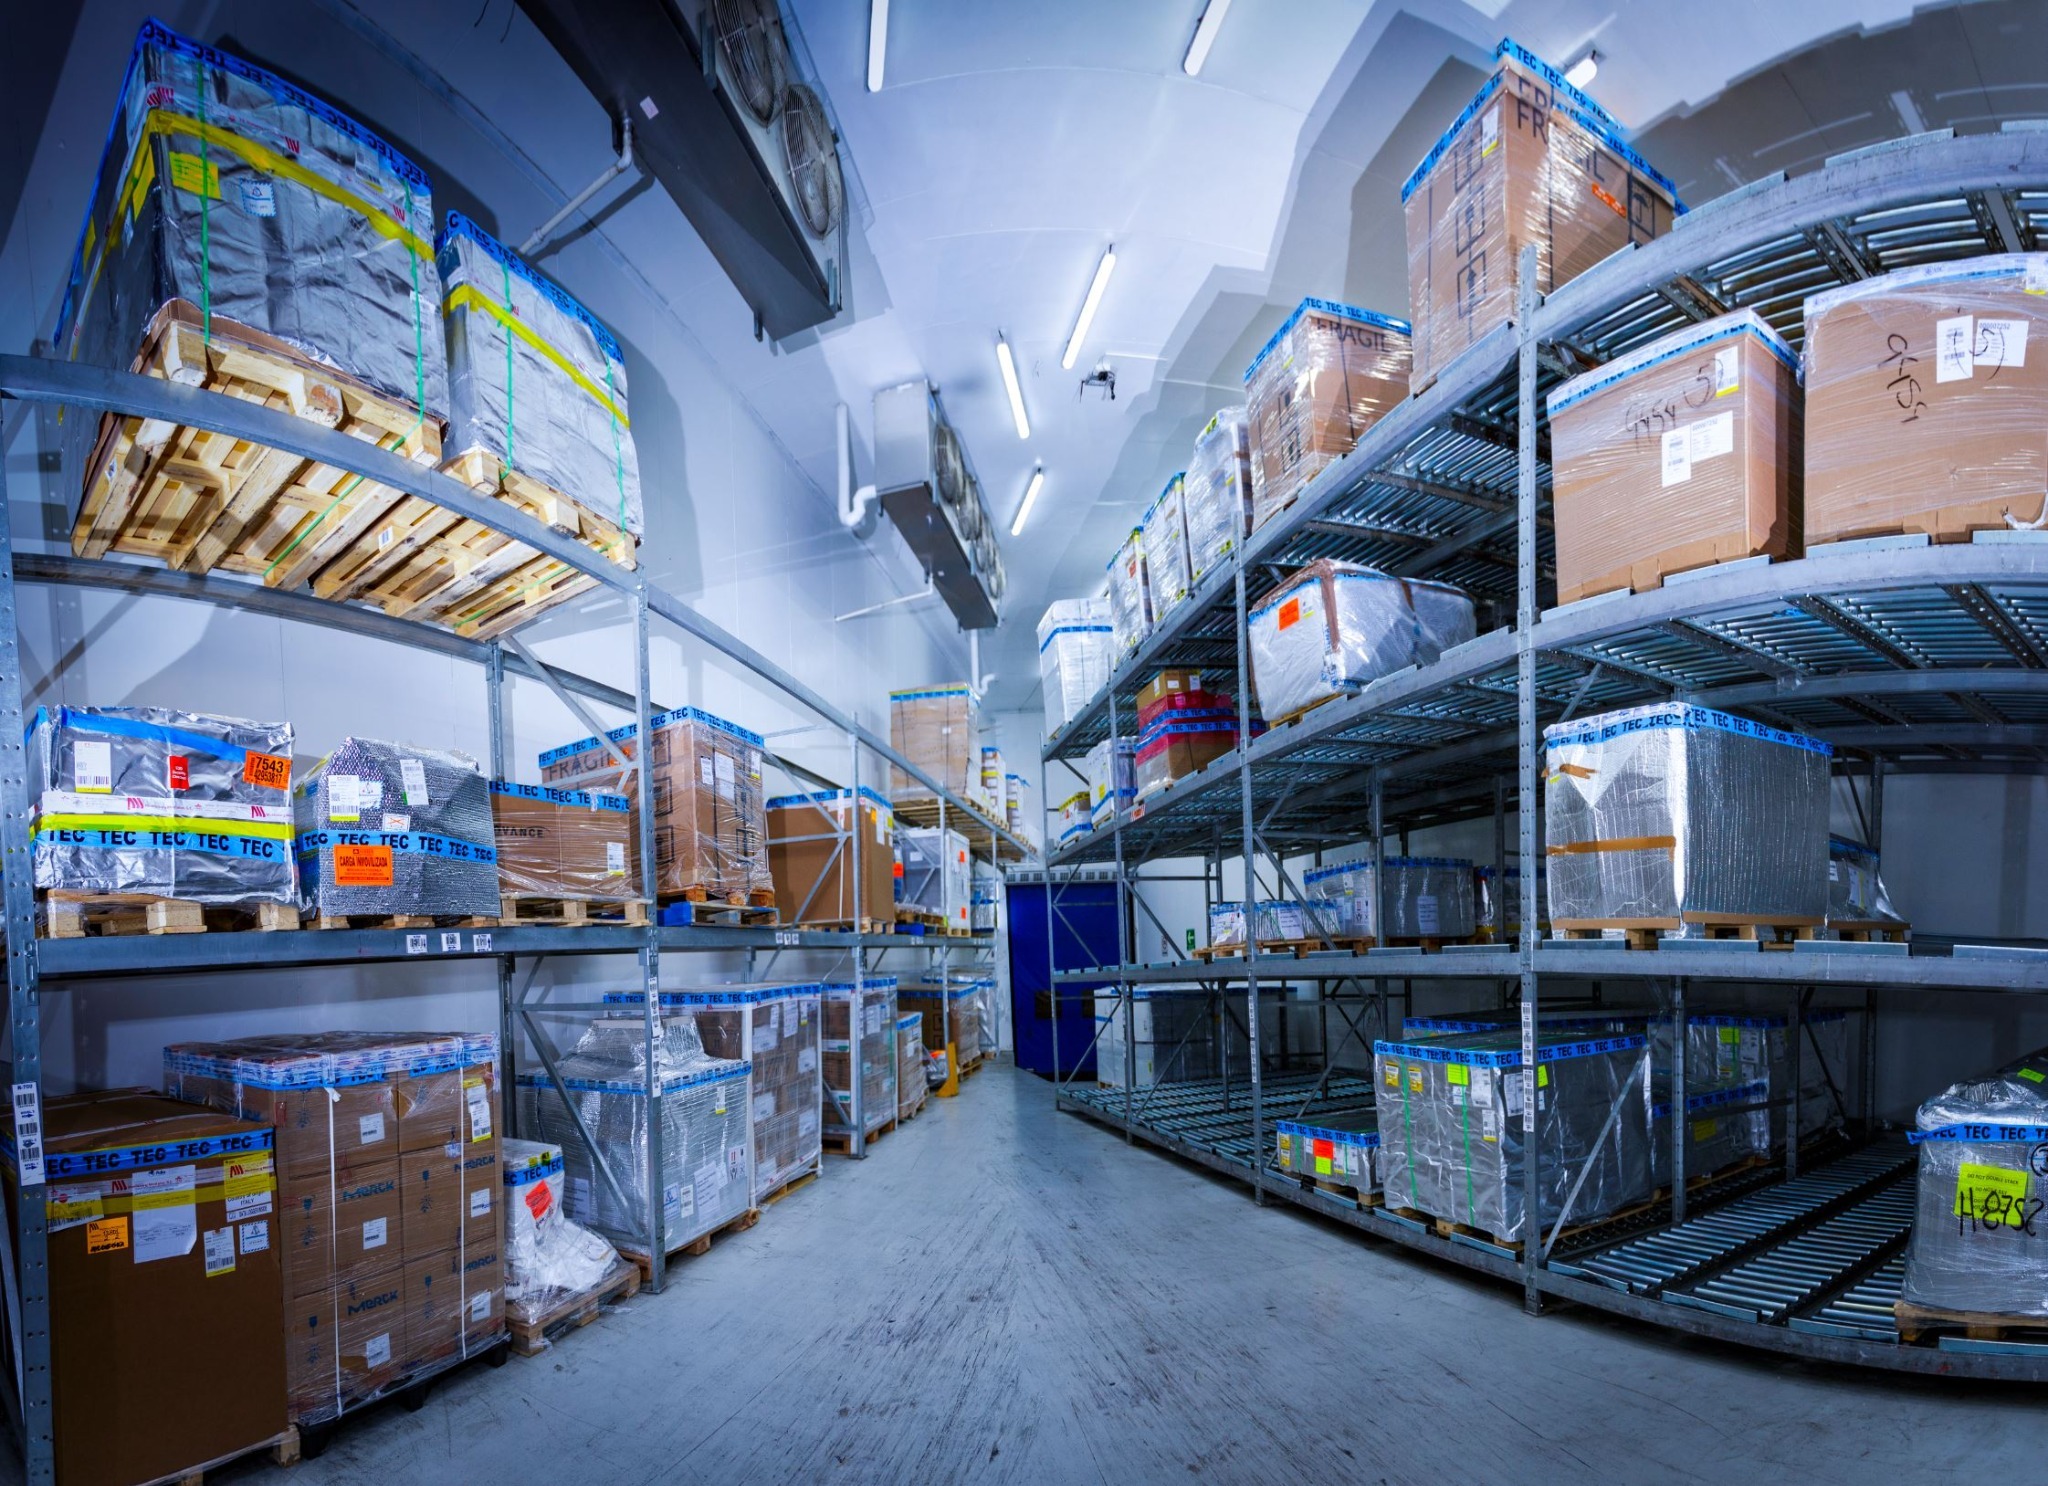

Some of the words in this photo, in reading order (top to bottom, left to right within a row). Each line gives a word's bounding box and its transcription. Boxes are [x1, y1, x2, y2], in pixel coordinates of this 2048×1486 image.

[1516, 44, 1537, 70] TEC
[1542, 64, 1562, 88] TEC
[1306, 298, 1322, 309] TEC
[1326, 302, 1342, 313] TEC
[1345, 307, 1361, 318] TEC
[1365, 312, 1381, 323] TEC
[555, 747, 568, 757] TEC
[572, 741, 586, 751] TEC
[591, 736, 600, 746] TE
[628, 722, 637, 734] TE
[671, 707, 688, 720] TEC
[693, 708, 706, 720] TEC
[751, 733, 760, 744] TEC
[1622, 718, 1642, 731] TEC
[1711, 713, 1729, 727] TEC
[1732, 718, 1749, 733] TEC
[1753, 723, 1770, 737] TEC
[255, 757, 284, 773] 7543
[489, 781, 510, 792] TEC
[517, 784, 538, 797] TEC
[577, 793, 591, 803] TE
[602, 796, 620, 809] TEC
[814, 793, 826, 801] TEC
[100, 829, 136, 846] TEC
[150, 830, 186, 846] TEC
[196, 832, 230, 851] TEC
[240, 836, 273, 858] TEC
[304, 833, 328, 847] TEC
[338, 834, 371, 846] TEC
[380, 834, 409, 849] TEC
[418, 836, 443, 853] TEC
[449, 842, 469, 857] TEC
[474, 848, 492, 861] TEC
[689, 995, 704, 1003] TEC
[708, 995, 723, 1003] TEC
[728, 994, 741, 1002] TEC
[1432, 1022, 1444, 1030] TEC
[1447, 1022, 1459, 1030] TEC
[1376, 1044, 1388, 1052] TEC
[1392, 1045, 1405, 1055] TEC
[1408, 1048, 1422, 1058] TEC
[1455, 1052, 1470, 1063] TEC
[1474, 1054, 1490, 1065] TEC
[1495, 1054, 1512, 1066] TEC
[1538, 1049, 1553, 1060] TEC
[1557, 1046, 1572, 1057] TEC
[1576, 1043, 1591, 1054] TEC
[1594, 1040, 1608, 1051] TEC
[1612, 1038, 1626, 1049] TEC
[1629, 1036, 1642, 1046] TEC
[1285, 1124, 1295, 1132] TEC
[1297, 1126, 1307, 1134] TEC
[1335, 1132, 1348, 1141] TEC
[1351, 1134, 1361, 1144] TEC
[1964, 1125, 1991, 1139] TEC
[2000, 1127, 2026, 1139] TEC
[44, 1157, 72, 1175] EC
[85, 1153, 120, 1171] TEC
[131, 1147, 166, 1165] TEC
[176, 1141, 210, 1159] TEC
[220, 1135, 252, 1152] TEC
[503, 1172, 517, 1185] EC
[523, 1167, 542, 1181] TEC
[547, 1160, 561, 1173] TEC
[348, 1290, 398, 1315] MERCK
